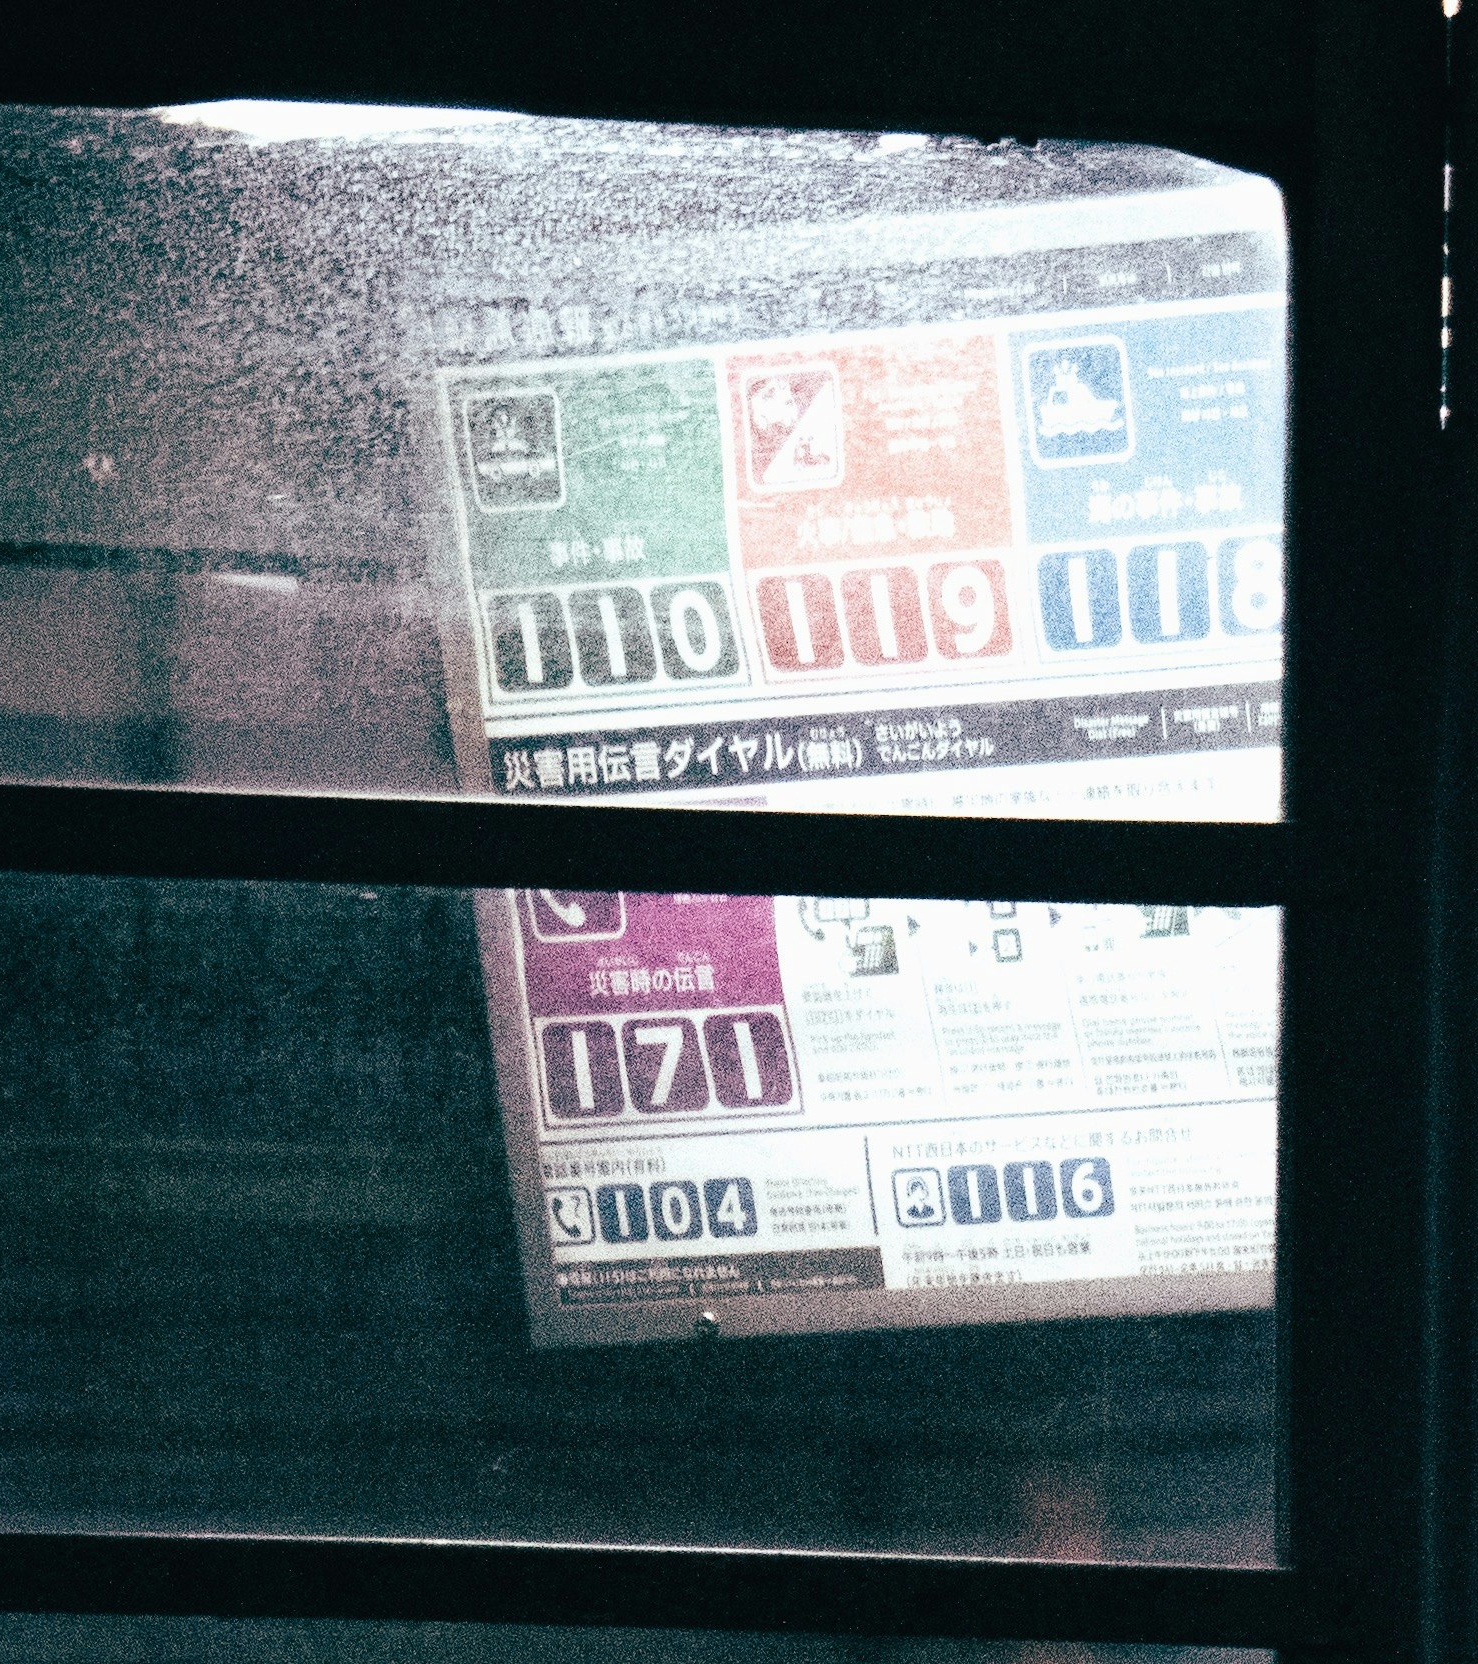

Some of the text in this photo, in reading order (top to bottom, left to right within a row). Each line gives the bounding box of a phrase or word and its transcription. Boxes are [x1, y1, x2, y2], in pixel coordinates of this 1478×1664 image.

[517, 589, 722, 684] 110
[784, 564, 996, 665] 119
[1067, 538, 1284, 644] 118
[570, 1021, 764, 1110] 171
[615, 1183, 748, 1239] 104
[966, 1161, 1104, 1219] 116
